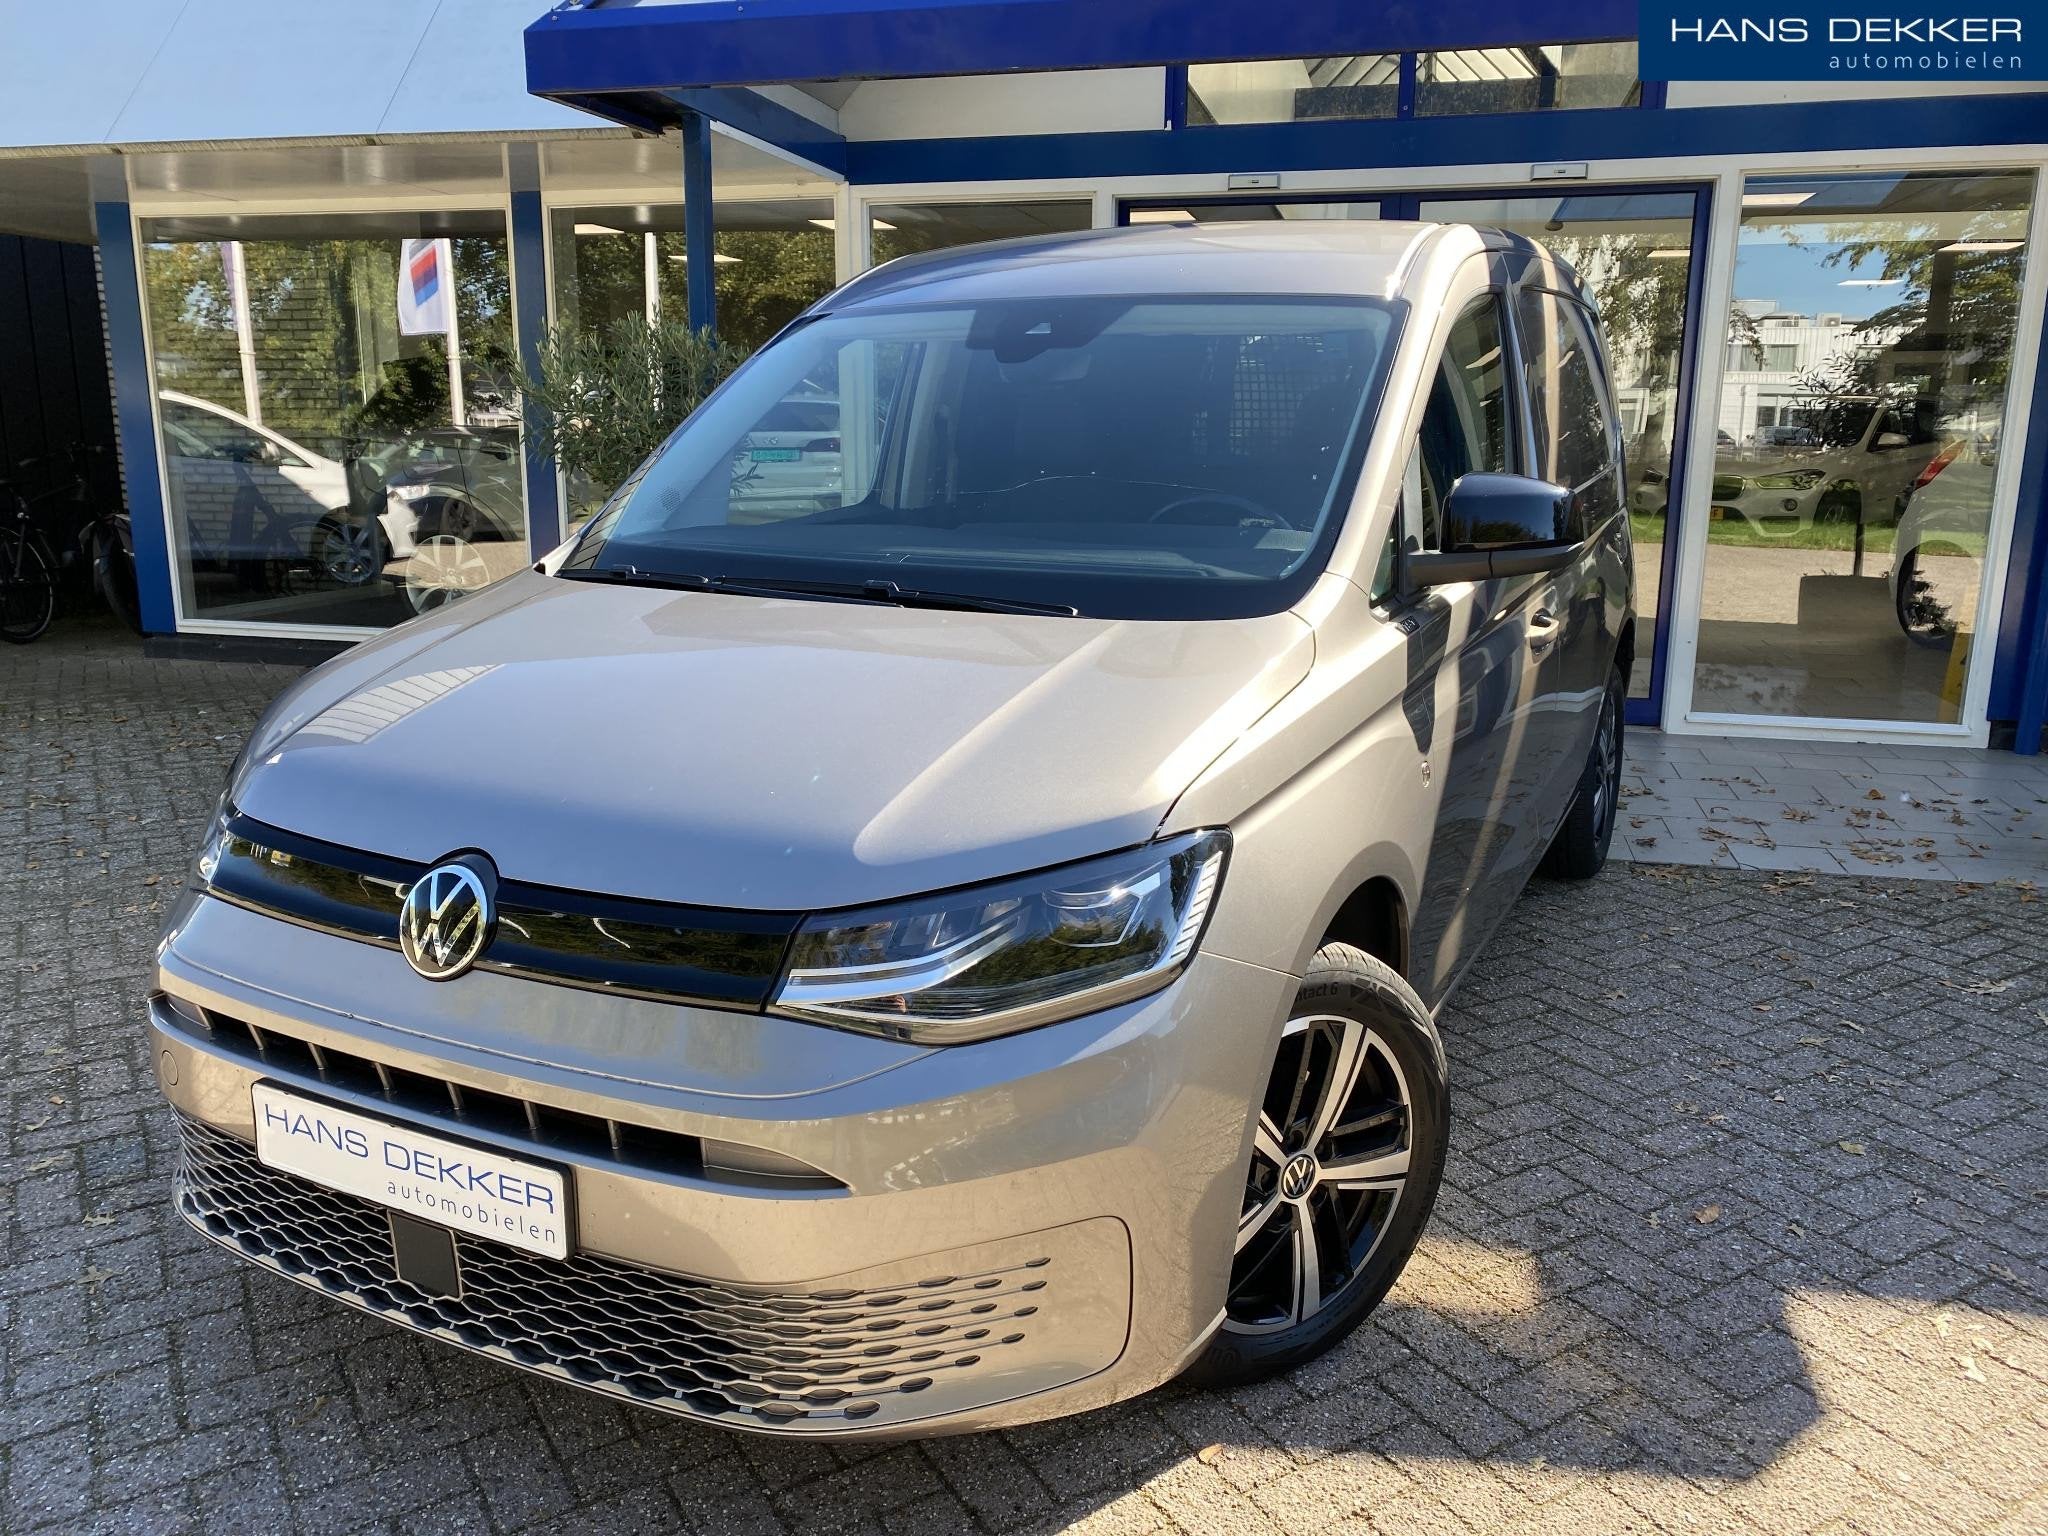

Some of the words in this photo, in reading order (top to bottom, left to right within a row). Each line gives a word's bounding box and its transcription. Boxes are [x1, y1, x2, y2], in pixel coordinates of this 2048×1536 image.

[1330, 981, 1338, 996] 6
[264, 1103, 369, 1158] HANS
[383, 1140, 554, 1214] DEKKER
[387, 1180, 556, 1244] automobielen
